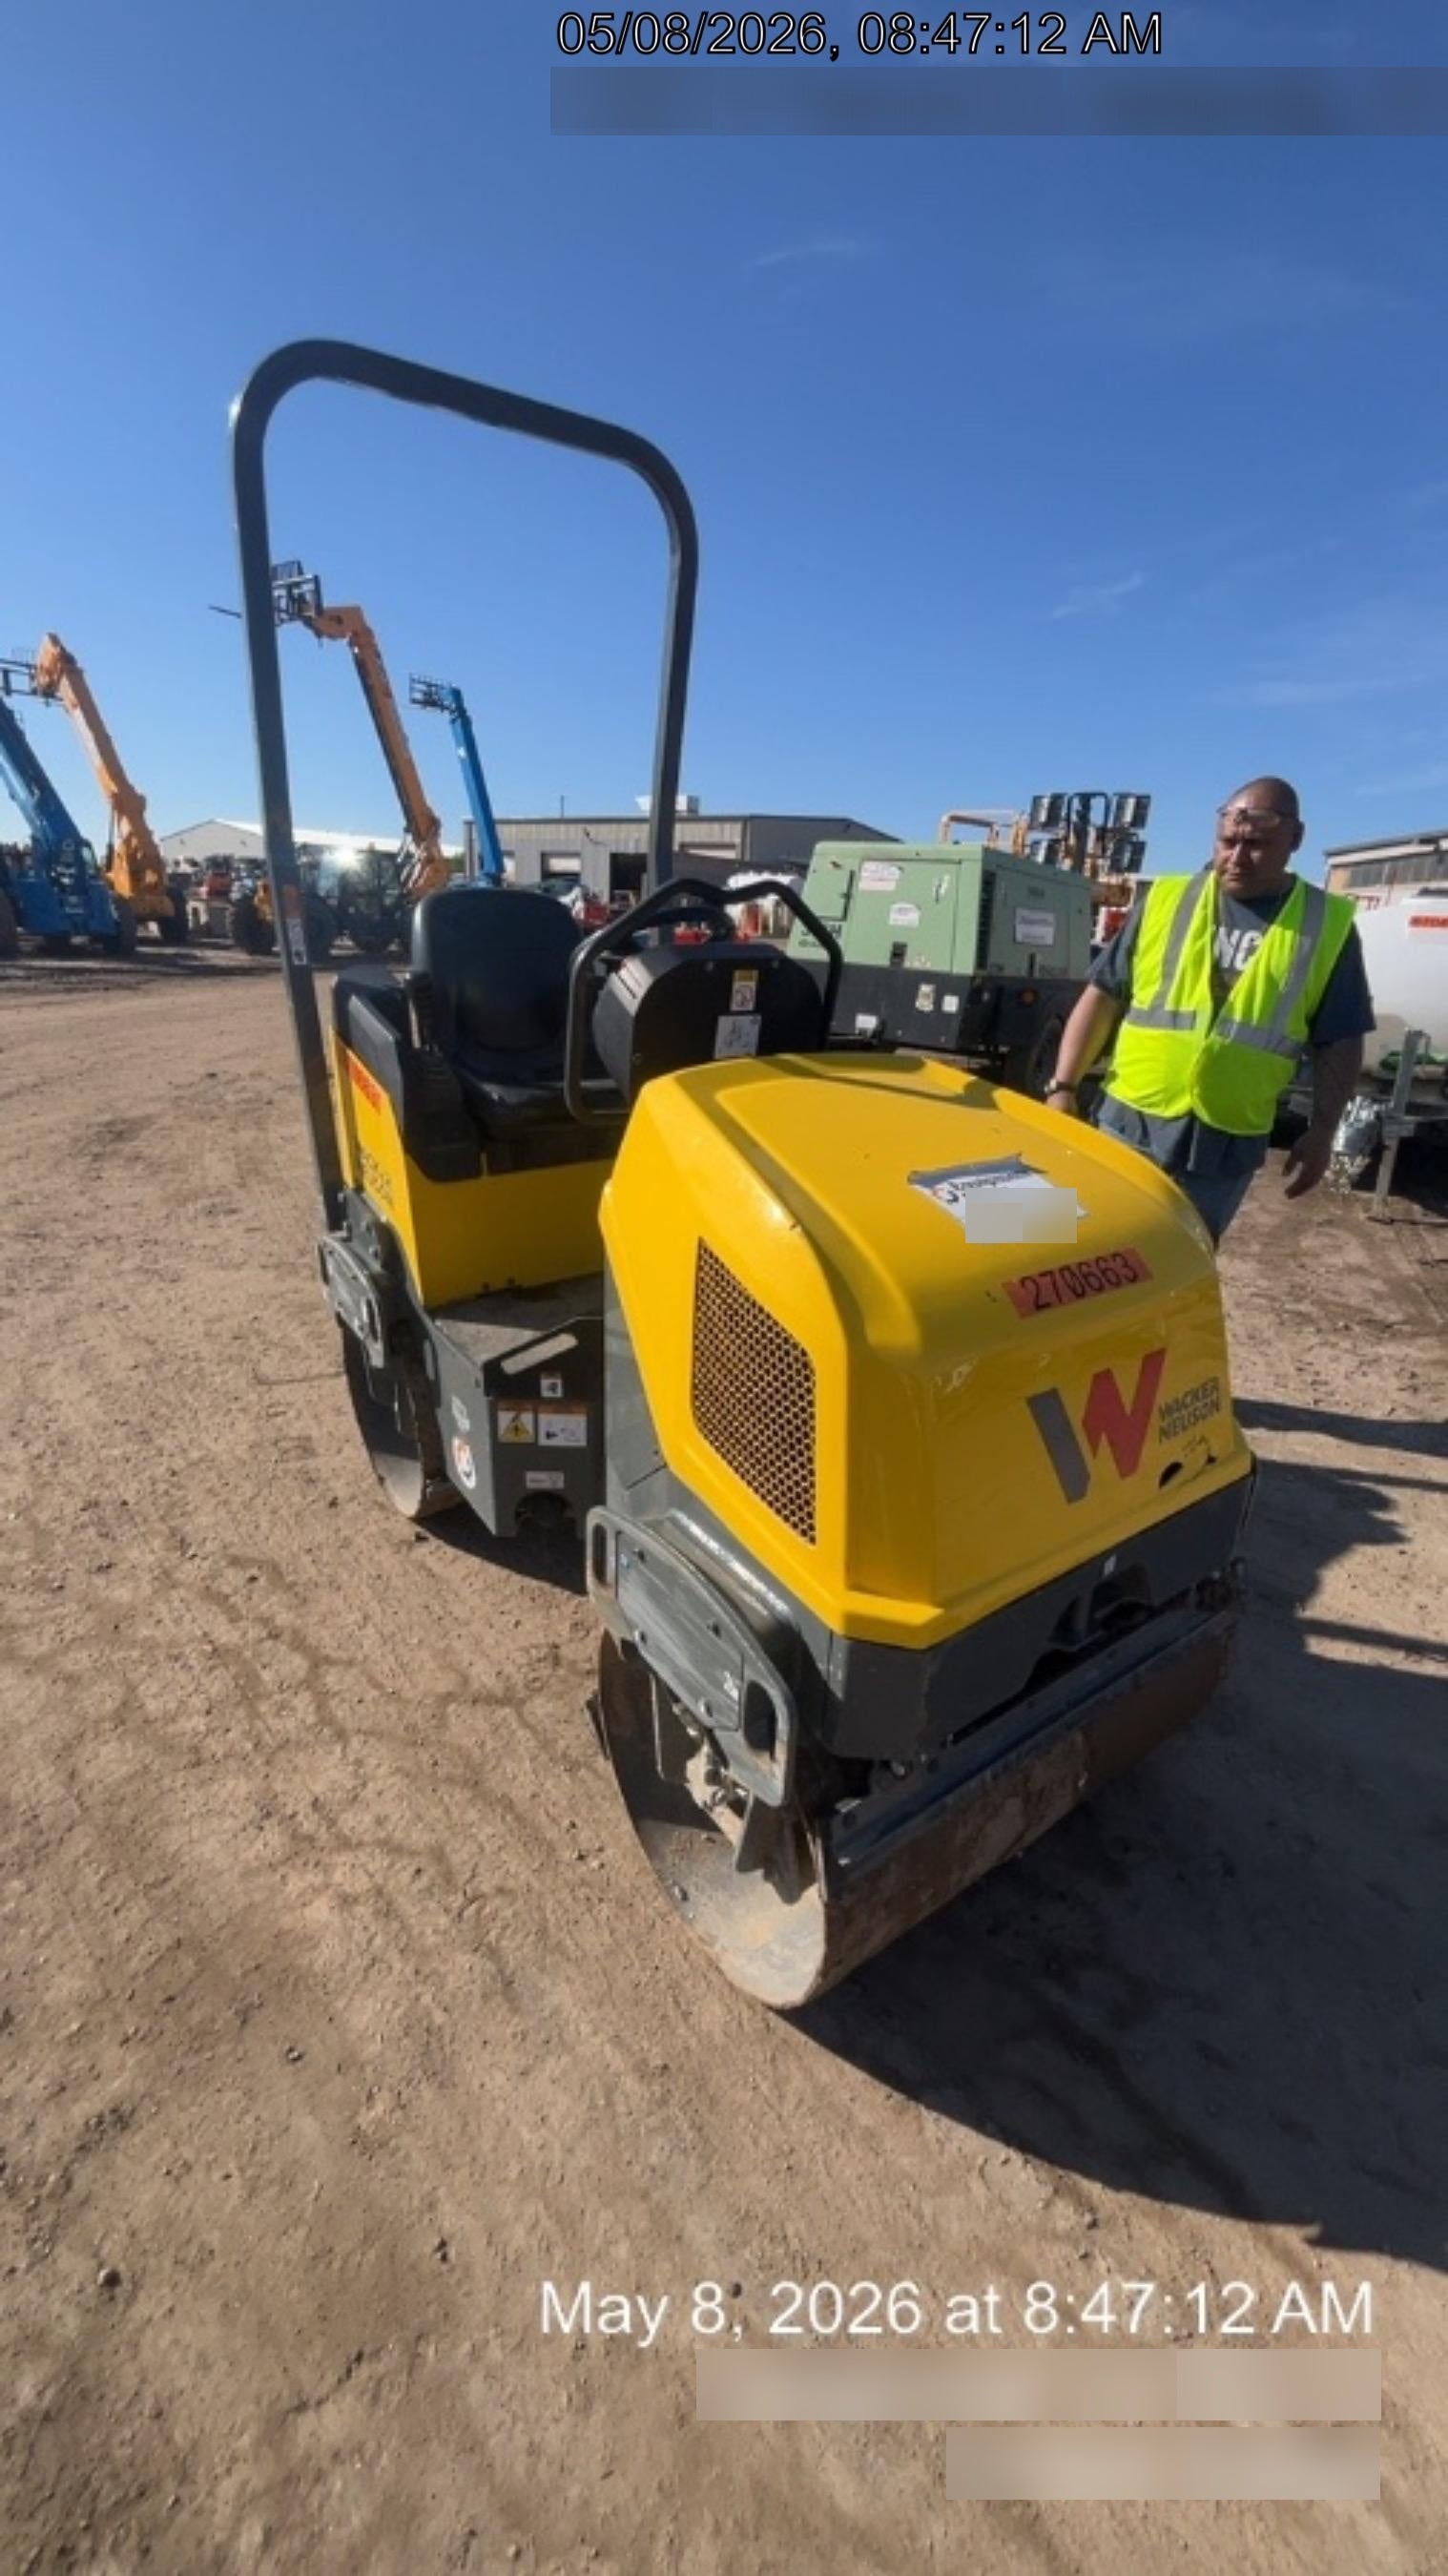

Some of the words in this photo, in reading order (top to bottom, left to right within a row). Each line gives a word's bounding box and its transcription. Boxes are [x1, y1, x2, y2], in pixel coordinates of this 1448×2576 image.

[1020, 1252, 1138, 1312] 270663
[1158, 1376, 1220, 1422] WACKER
[1158, 1396, 1220, 1444] NEUSON
